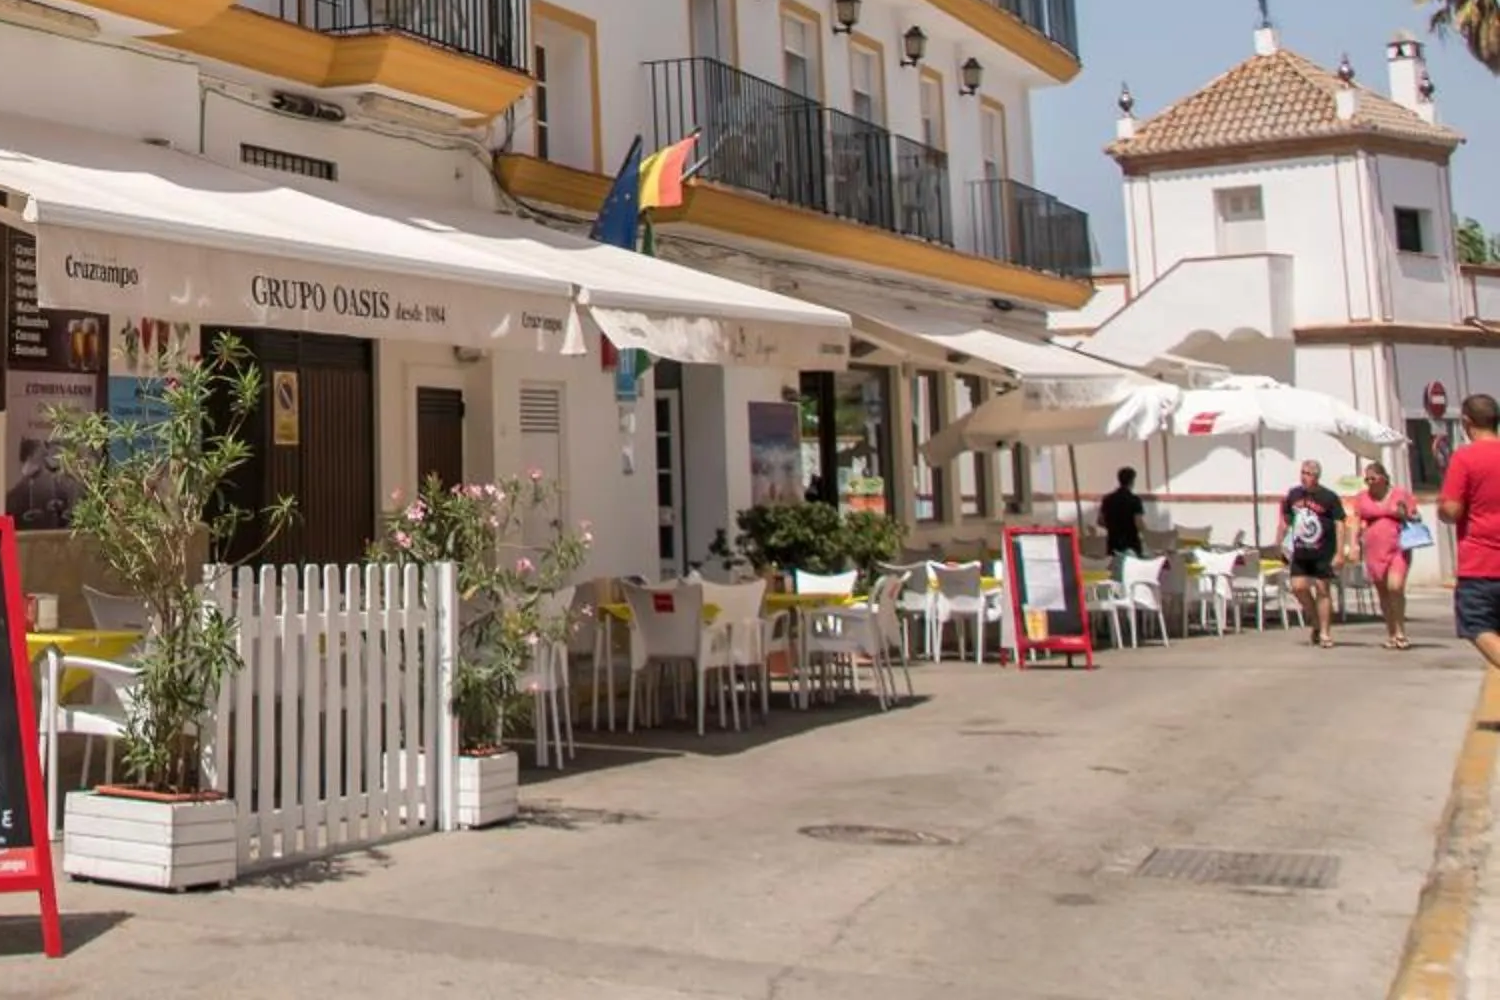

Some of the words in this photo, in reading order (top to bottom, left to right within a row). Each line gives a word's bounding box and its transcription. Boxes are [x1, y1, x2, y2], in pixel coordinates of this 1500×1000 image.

[65, 254, 139, 288] Cruzcampo
[251, 275, 327, 312] GRUPO
[333, 285, 390, 319] OASIS
[395, 301, 422, 322] desde
